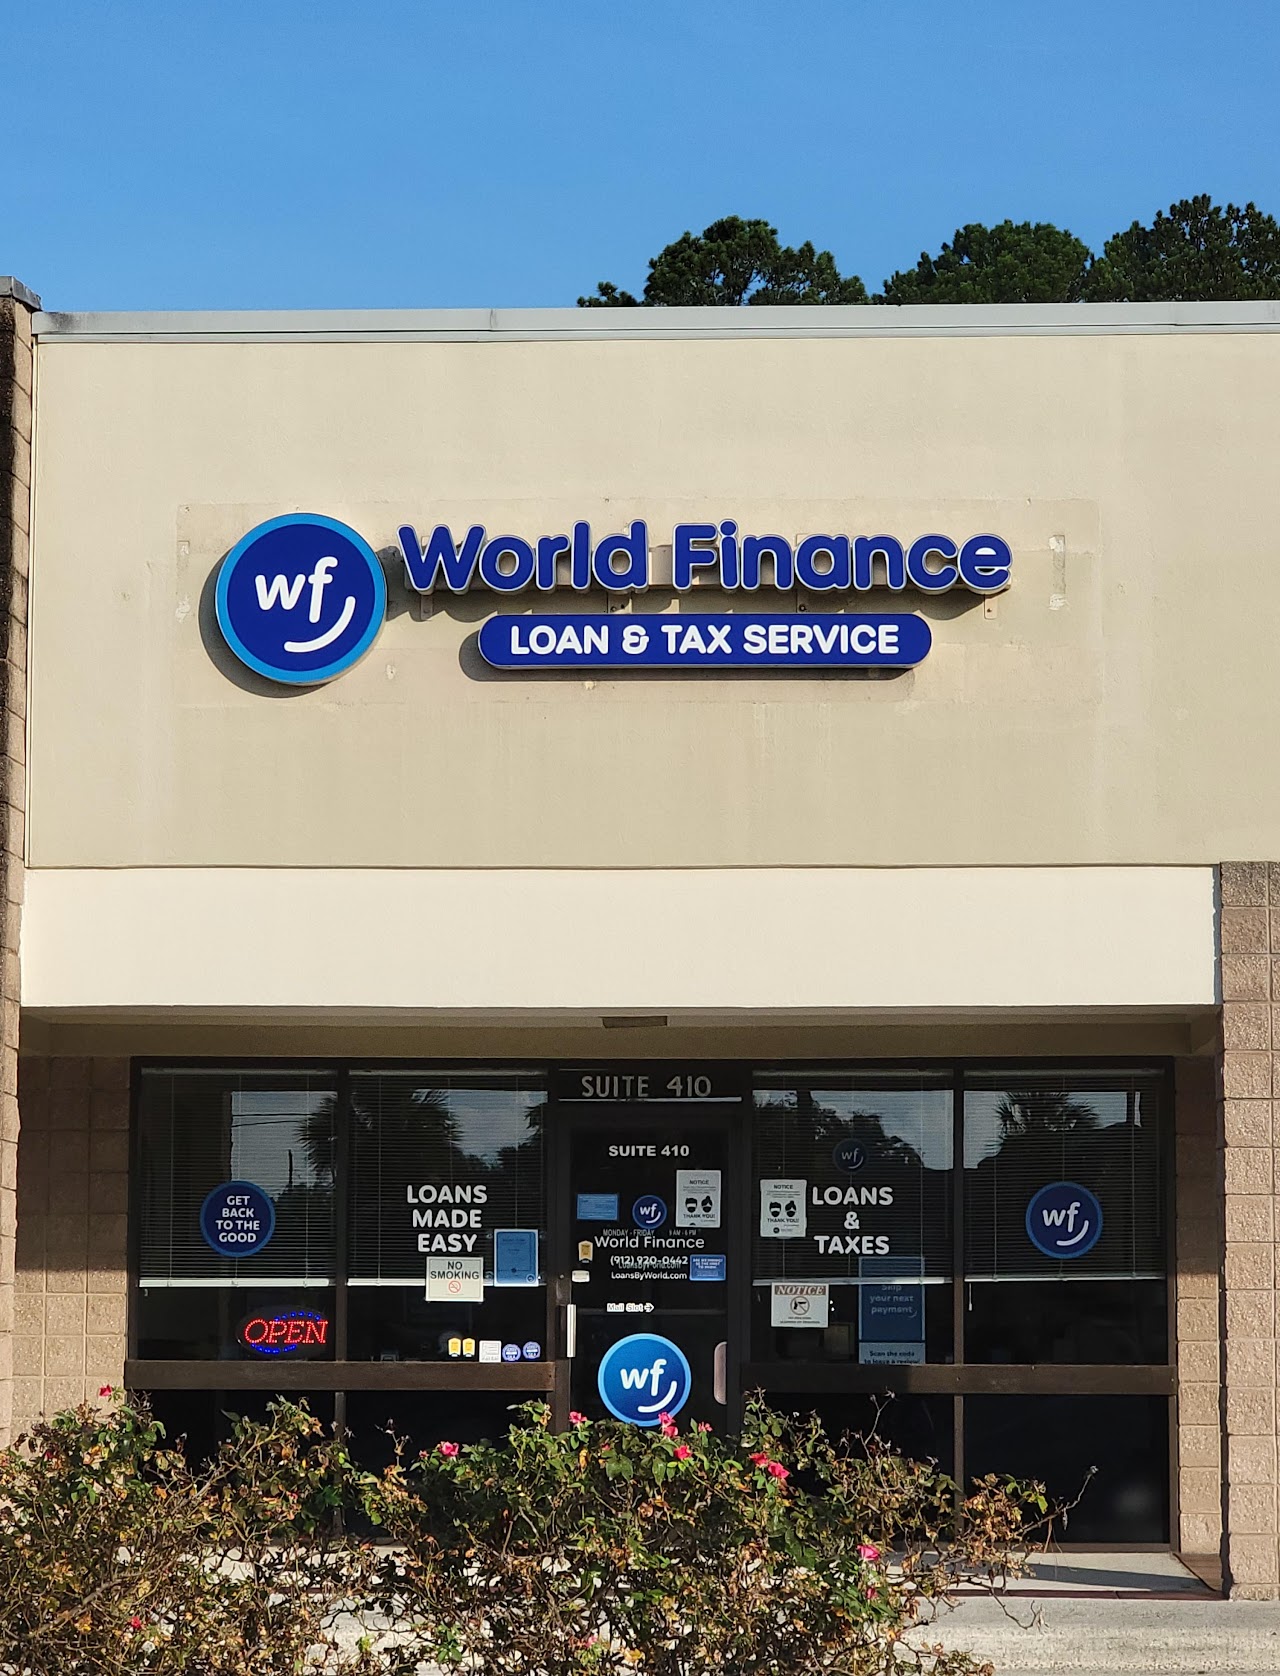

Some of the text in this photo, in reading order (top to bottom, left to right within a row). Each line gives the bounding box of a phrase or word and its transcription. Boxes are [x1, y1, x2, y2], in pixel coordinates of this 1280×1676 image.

[398, 519, 1013, 594] World Finance
[255, 556, 338, 624] wf
[510, 623, 900, 656] LOAN & TAX SERVICE
[581, 1075, 712, 1098] SUITE 410
[608, 1145, 690, 1157] SUITE 410
[840, 1147, 859, 1164] wf
[226, 1195, 250, 1206] GET
[406, 1184, 488, 1204] LOANS
[811, 1186, 894, 1206] LOANS
[221, 1207, 255, 1218] BACK
[639, 1203, 658, 1218] wf
[1042, 1202, 1081, 1233] wf
[216, 1219, 260, 1231] TO THE
[411, 1208, 483, 1229] MADE
[843, 1211, 861, 1230] &
[218, 1232, 257, 1243] GOOD
[602, 1228, 629, 1237] MONDAY
[633, 1228, 655, 1237] FRIDAY
[417, 1233, 478, 1253] EASY
[594, 1235, 705, 1249] World Finance
[813, 1236, 890, 1255] TAXES
[447, 1261, 463, 1270] NO
[610, 1255, 634, 1267] (912)
[636, 1255, 688, 1265] 920-0442
[430, 1270, 480, 1280] SMOKING
[611, 1271, 688, 1281] LoansByWorld.com
[776, 1285, 825, 1295] NOTICE
[870, 1295, 891, 1303] your
[608, 1303, 644, 1312] Mail Slot
[871, 1306, 913, 1315] payment
[243, 1318, 329, 1345] OPEN
[620, 1358, 667, 1397] wf
